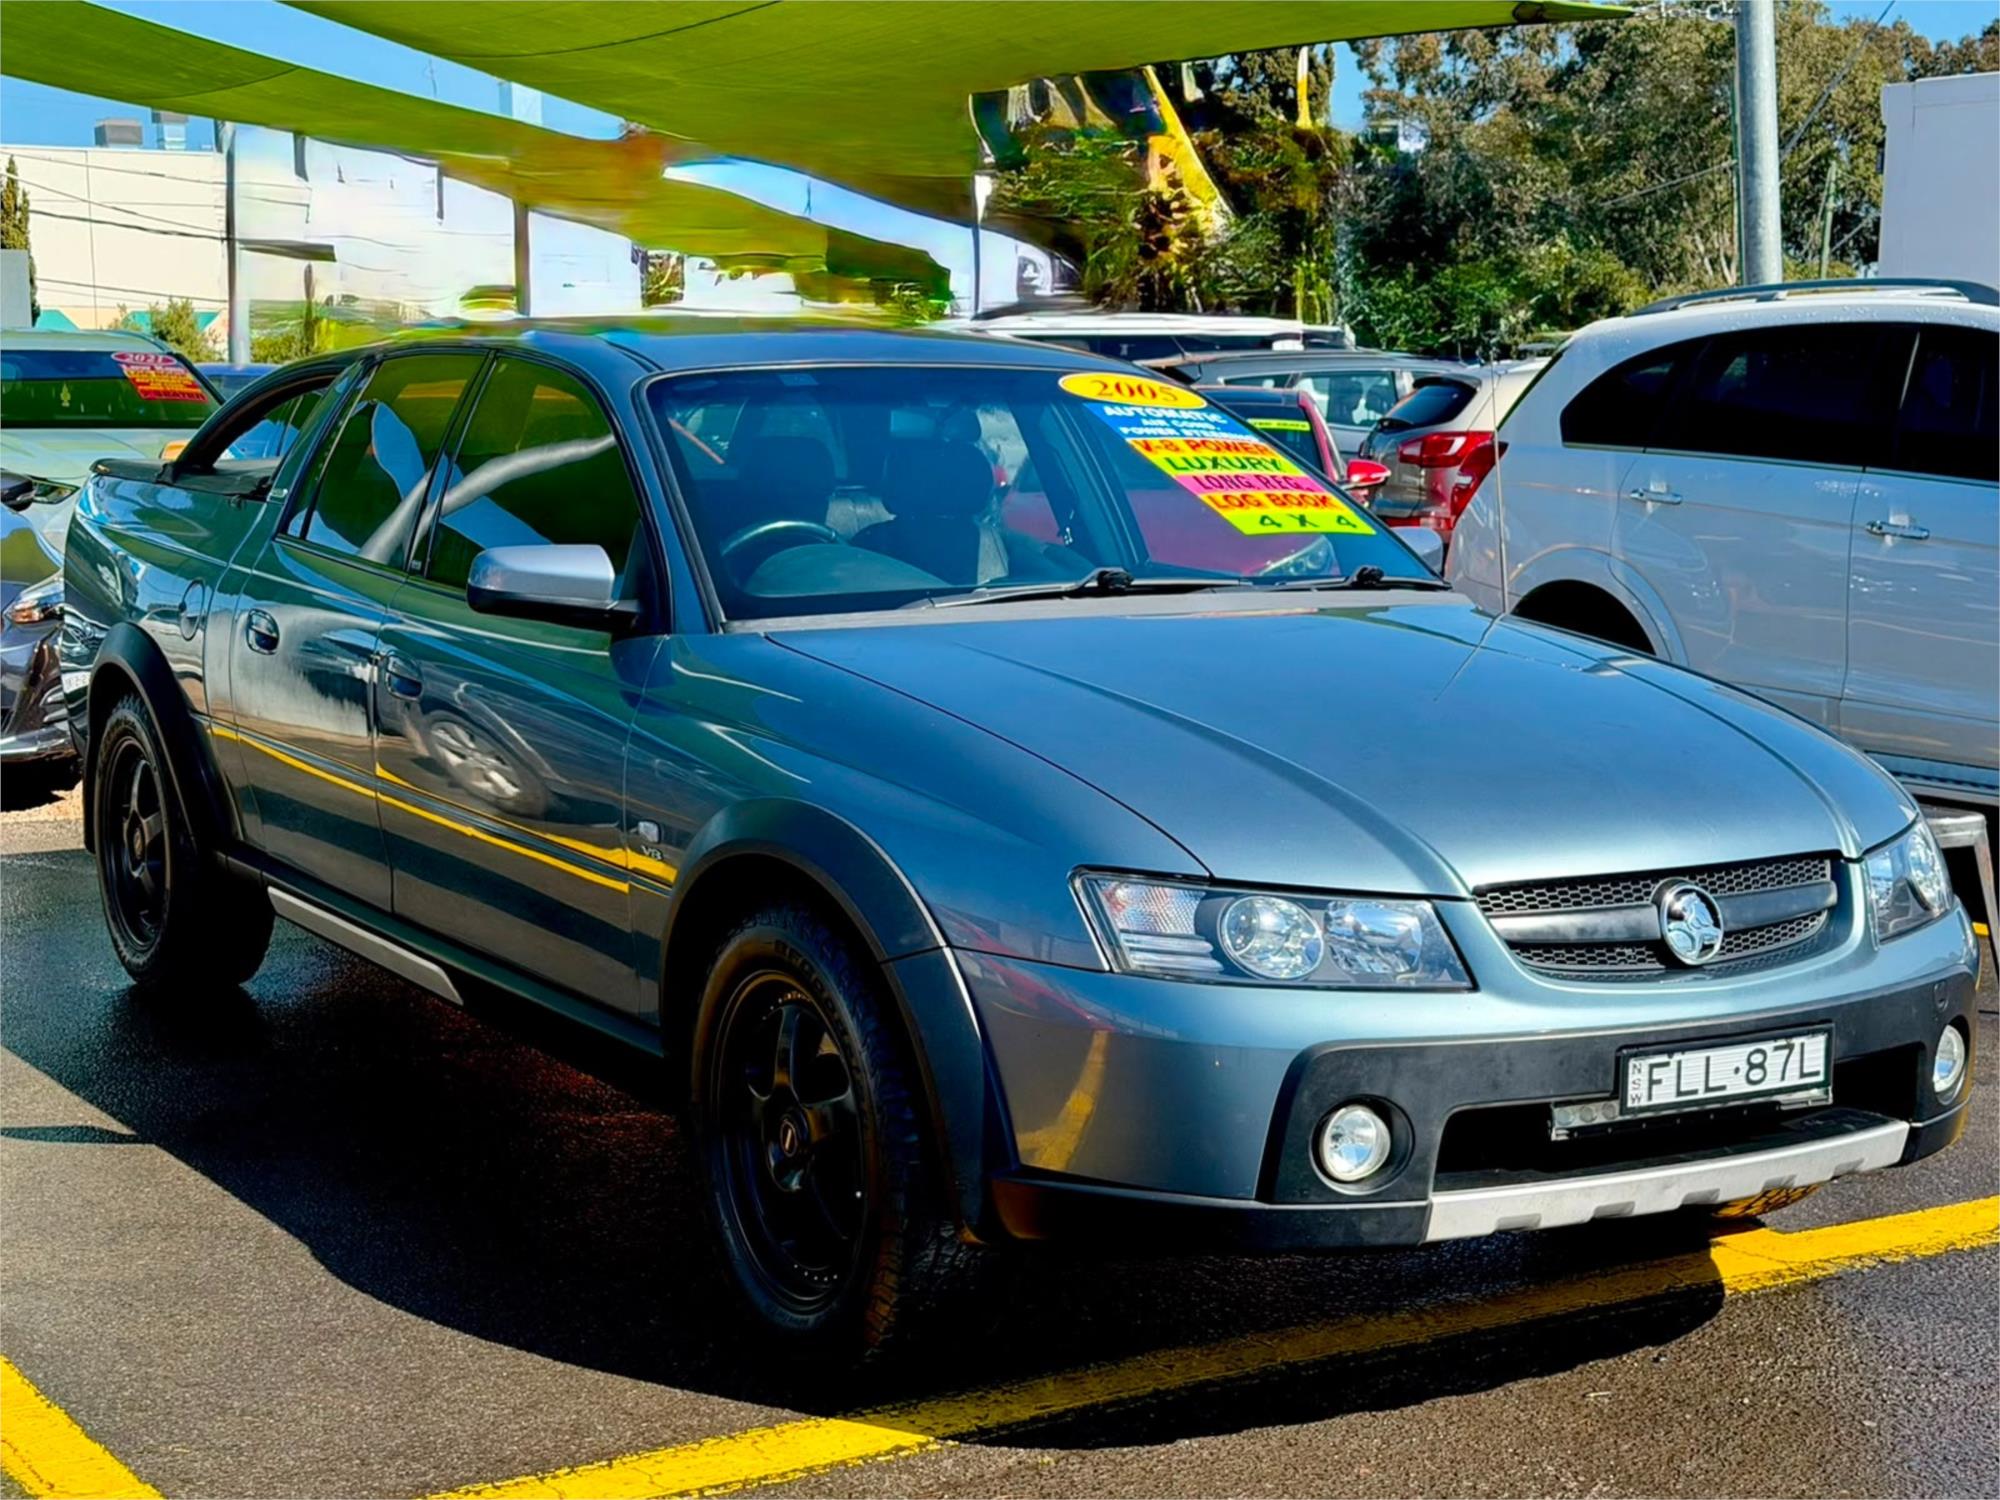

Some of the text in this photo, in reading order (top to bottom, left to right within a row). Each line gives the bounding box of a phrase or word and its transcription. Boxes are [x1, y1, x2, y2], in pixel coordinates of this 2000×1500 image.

[1090, 379, 1178, 402] 2005
[1103, 404, 1228, 425] AUTOMATIC
[1118, 426, 1181, 437] POWER
[1131, 438, 1276, 457] V-8 POWER
[1164, 455, 1284, 472] LUXURY
[1192, 474, 1254, 491] LONG
[1207, 492, 1344, 511] LOG BOOK
[1259, 514, 1283, 529] 4
[1336, 514, 1358, 529] 4
